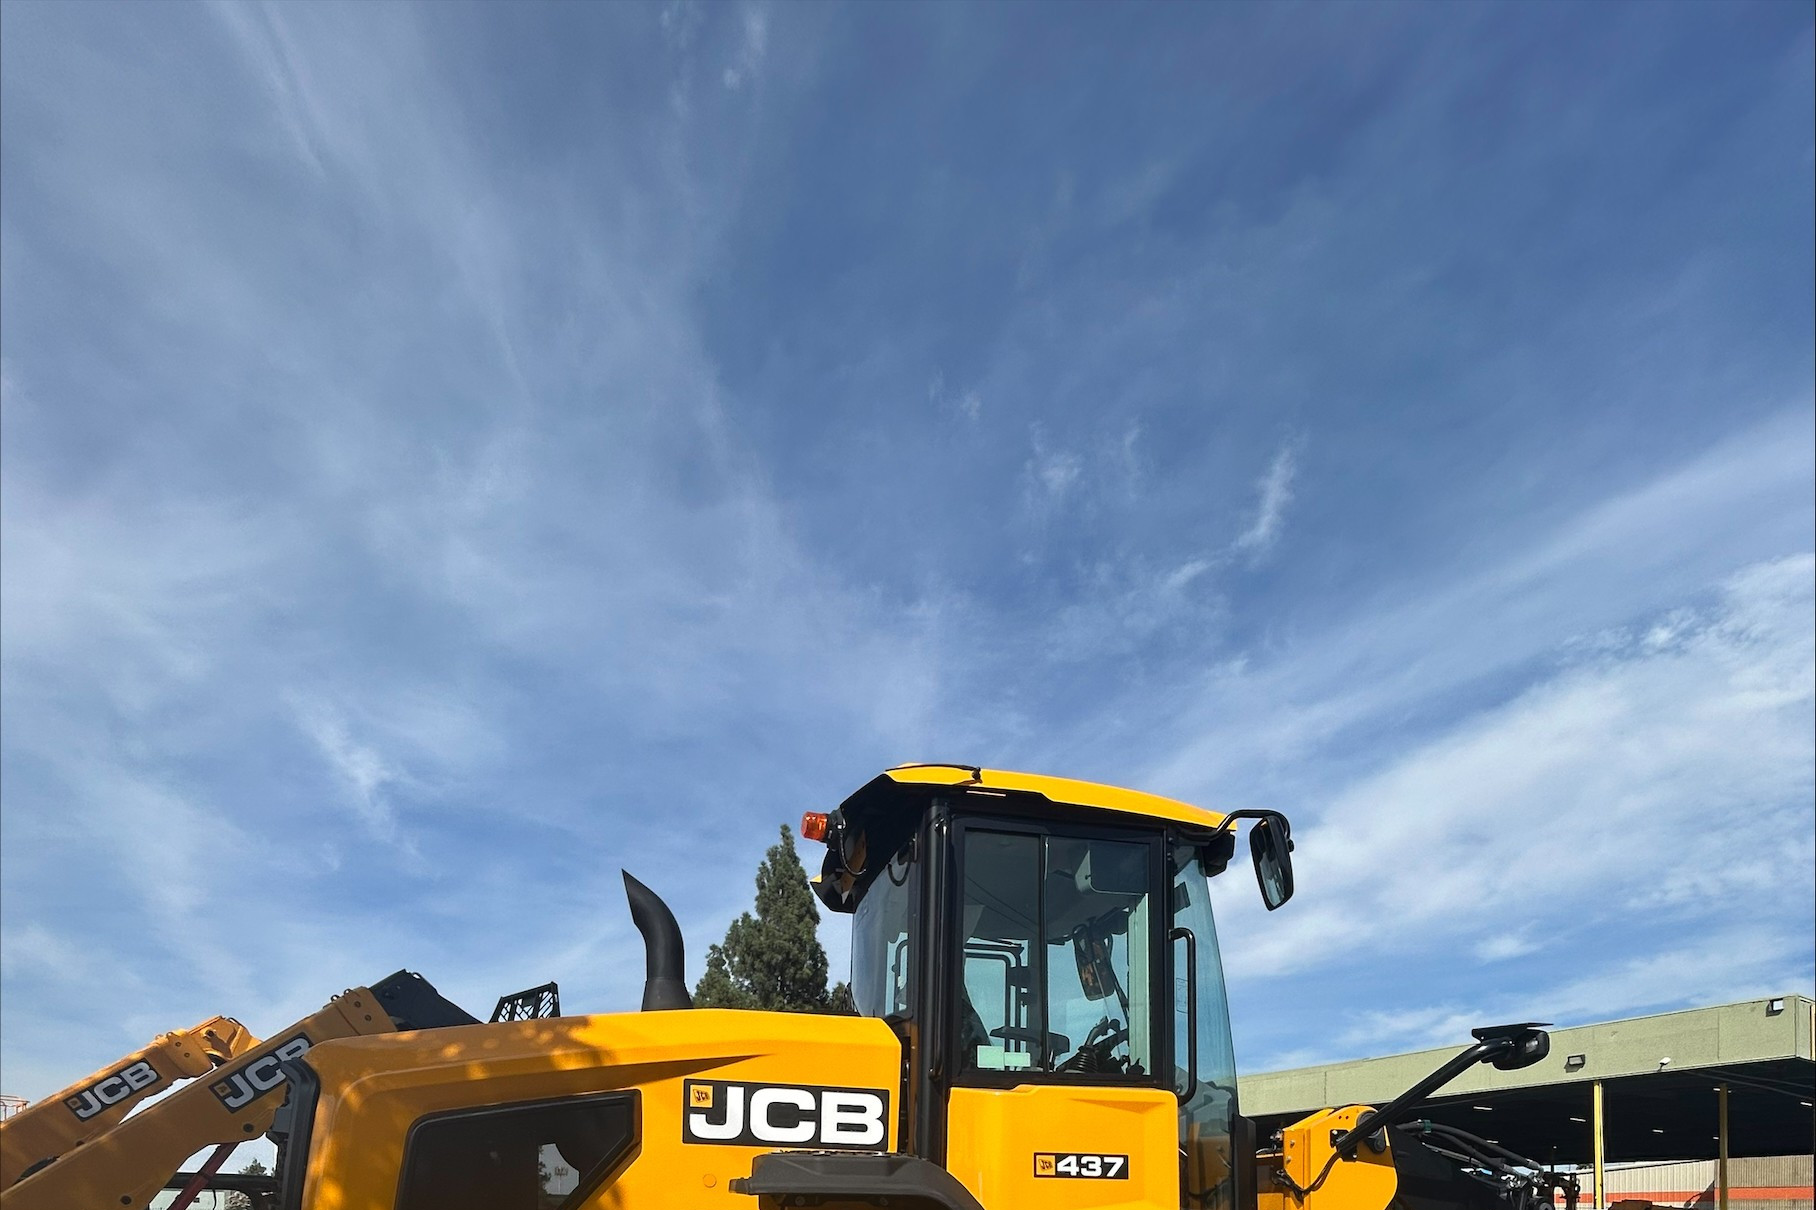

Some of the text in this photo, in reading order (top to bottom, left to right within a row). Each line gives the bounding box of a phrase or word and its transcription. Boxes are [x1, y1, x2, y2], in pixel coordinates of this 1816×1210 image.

[74, 1061, 159, 1119] JCB
[688, 1085, 885, 1146] JCB
[1056, 1155, 1125, 1177] 437
